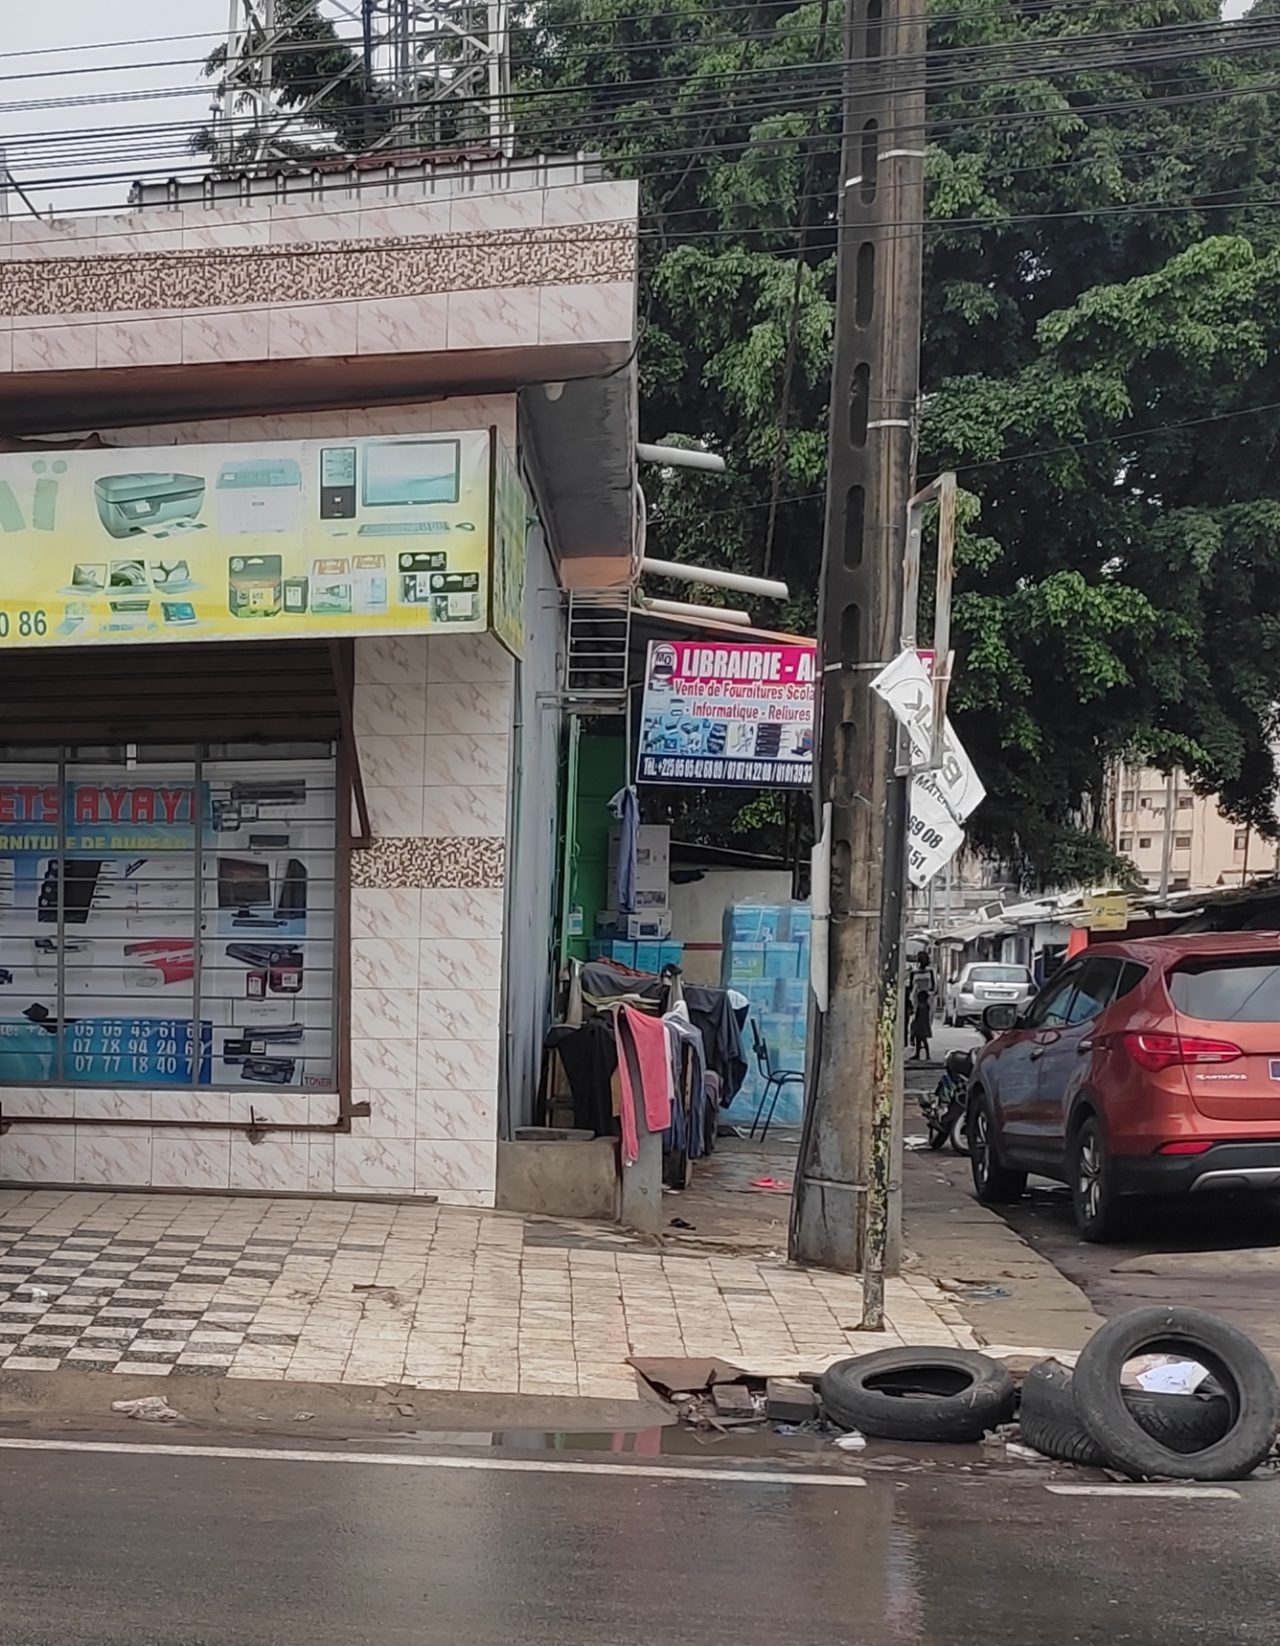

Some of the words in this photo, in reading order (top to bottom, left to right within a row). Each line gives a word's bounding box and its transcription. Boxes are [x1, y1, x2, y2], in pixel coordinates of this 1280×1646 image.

[18, 609, 48, 637] 86
[681, 649, 782, 681] LIBRAIRIE
[673, 680, 705, 697] Vente
[707, 681, 721, 697] de
[723, 682, 783, 700] Fournitures
[692, 701, 759, 722] Informatique
[768, 704, 811, 721] Reliures
[82, 836, 106, 850] DE
[922, 827, 943, 849] 08
[73, 1039, 90, 1054] 07
[101, 1039, 121, 1054] 78
[128, 1039, 148, 1054] 94
[157, 1040, 177, 1055] 20
[75, 1055, 94, 1073] 07
[103, 1056, 121, 1073] 77
[132, 1056, 149, 1073] 18
[156, 1056, 177, 1074] 40
